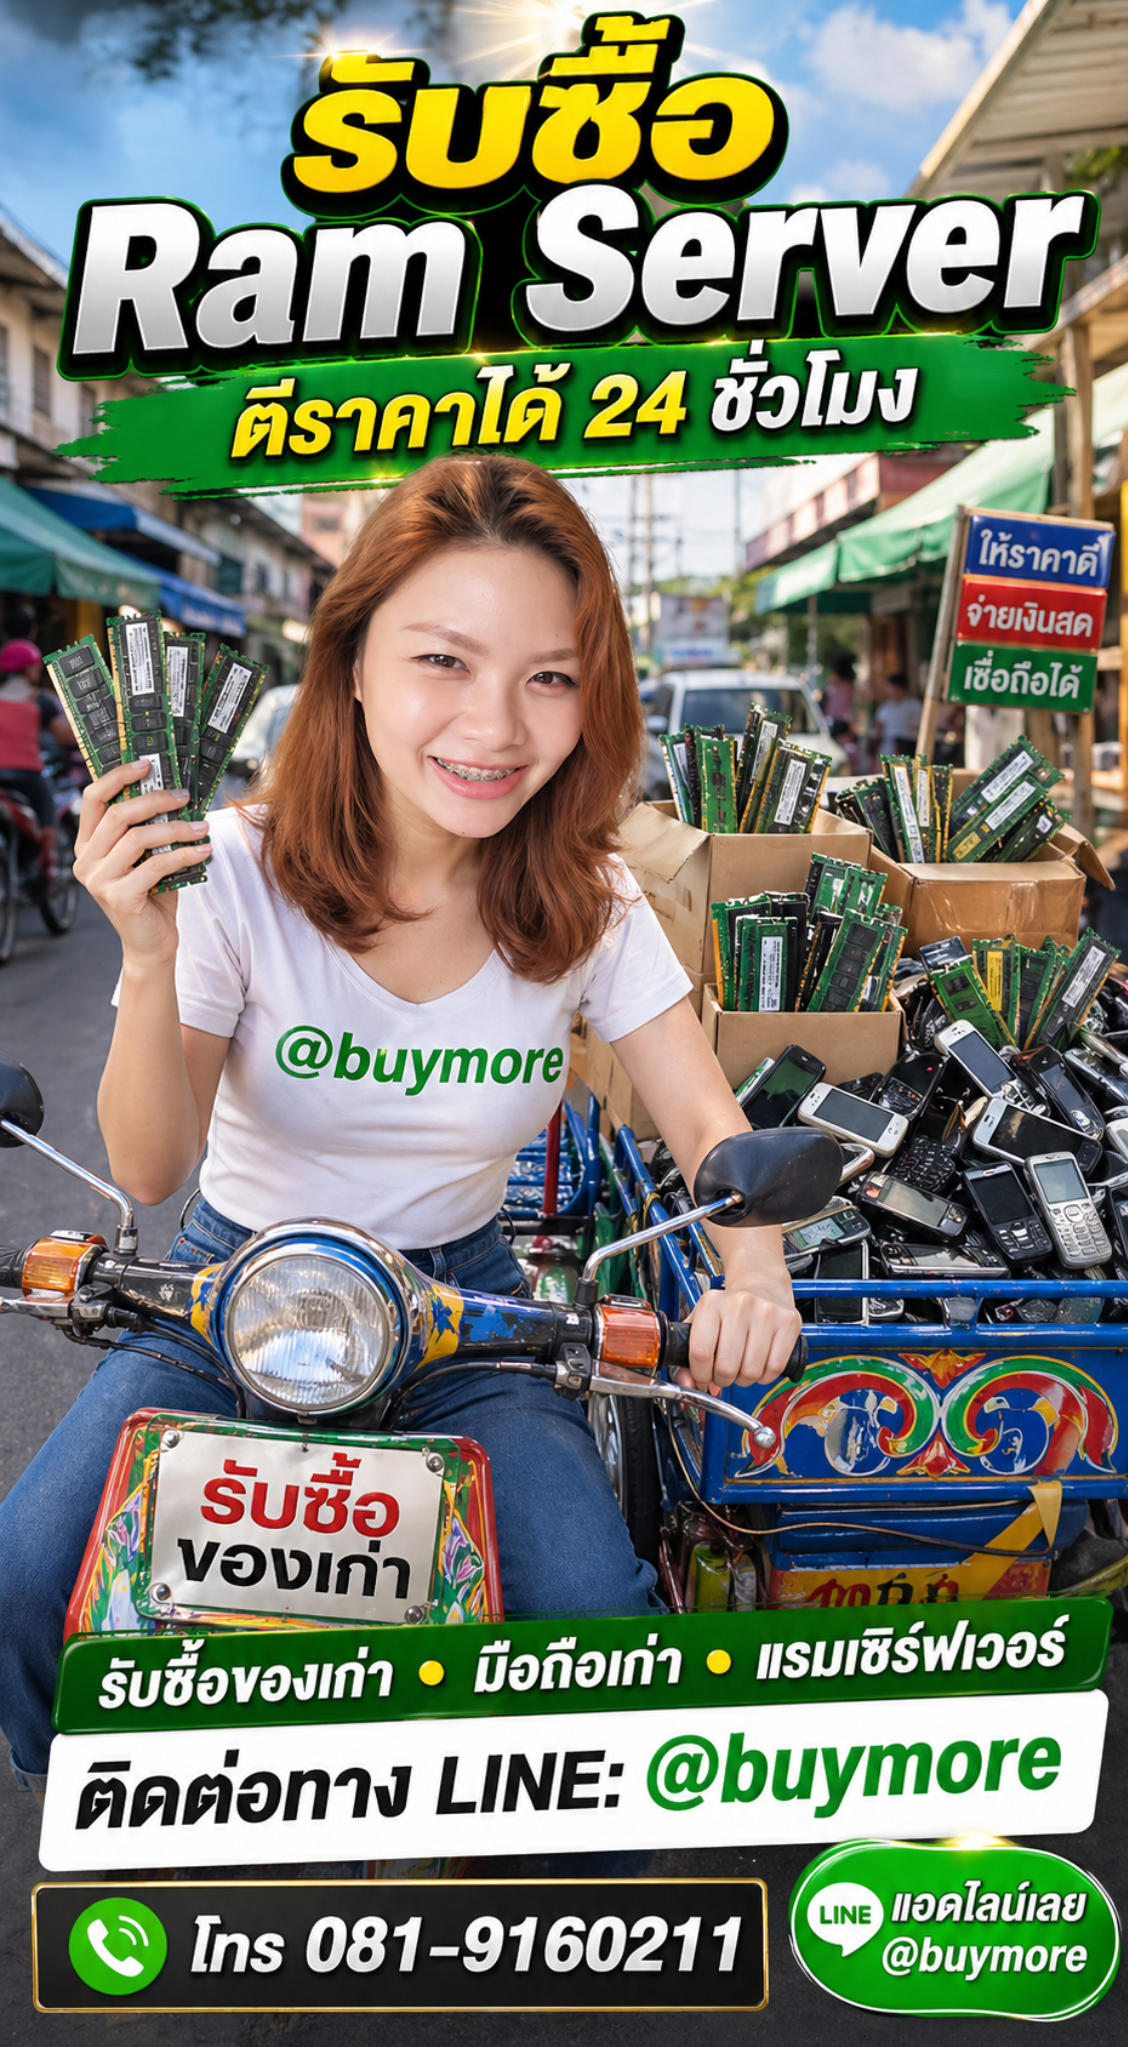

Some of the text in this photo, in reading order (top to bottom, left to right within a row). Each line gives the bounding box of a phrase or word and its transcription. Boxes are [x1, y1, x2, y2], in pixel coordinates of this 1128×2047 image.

[967, 594, 1094, 638] จ่ายเงินสด
[275, 1025, 564, 1097] @buymore
[199, 1452, 401, 1538] รับซื้อ
[176, 1538, 412, 1600] ของเก่า
